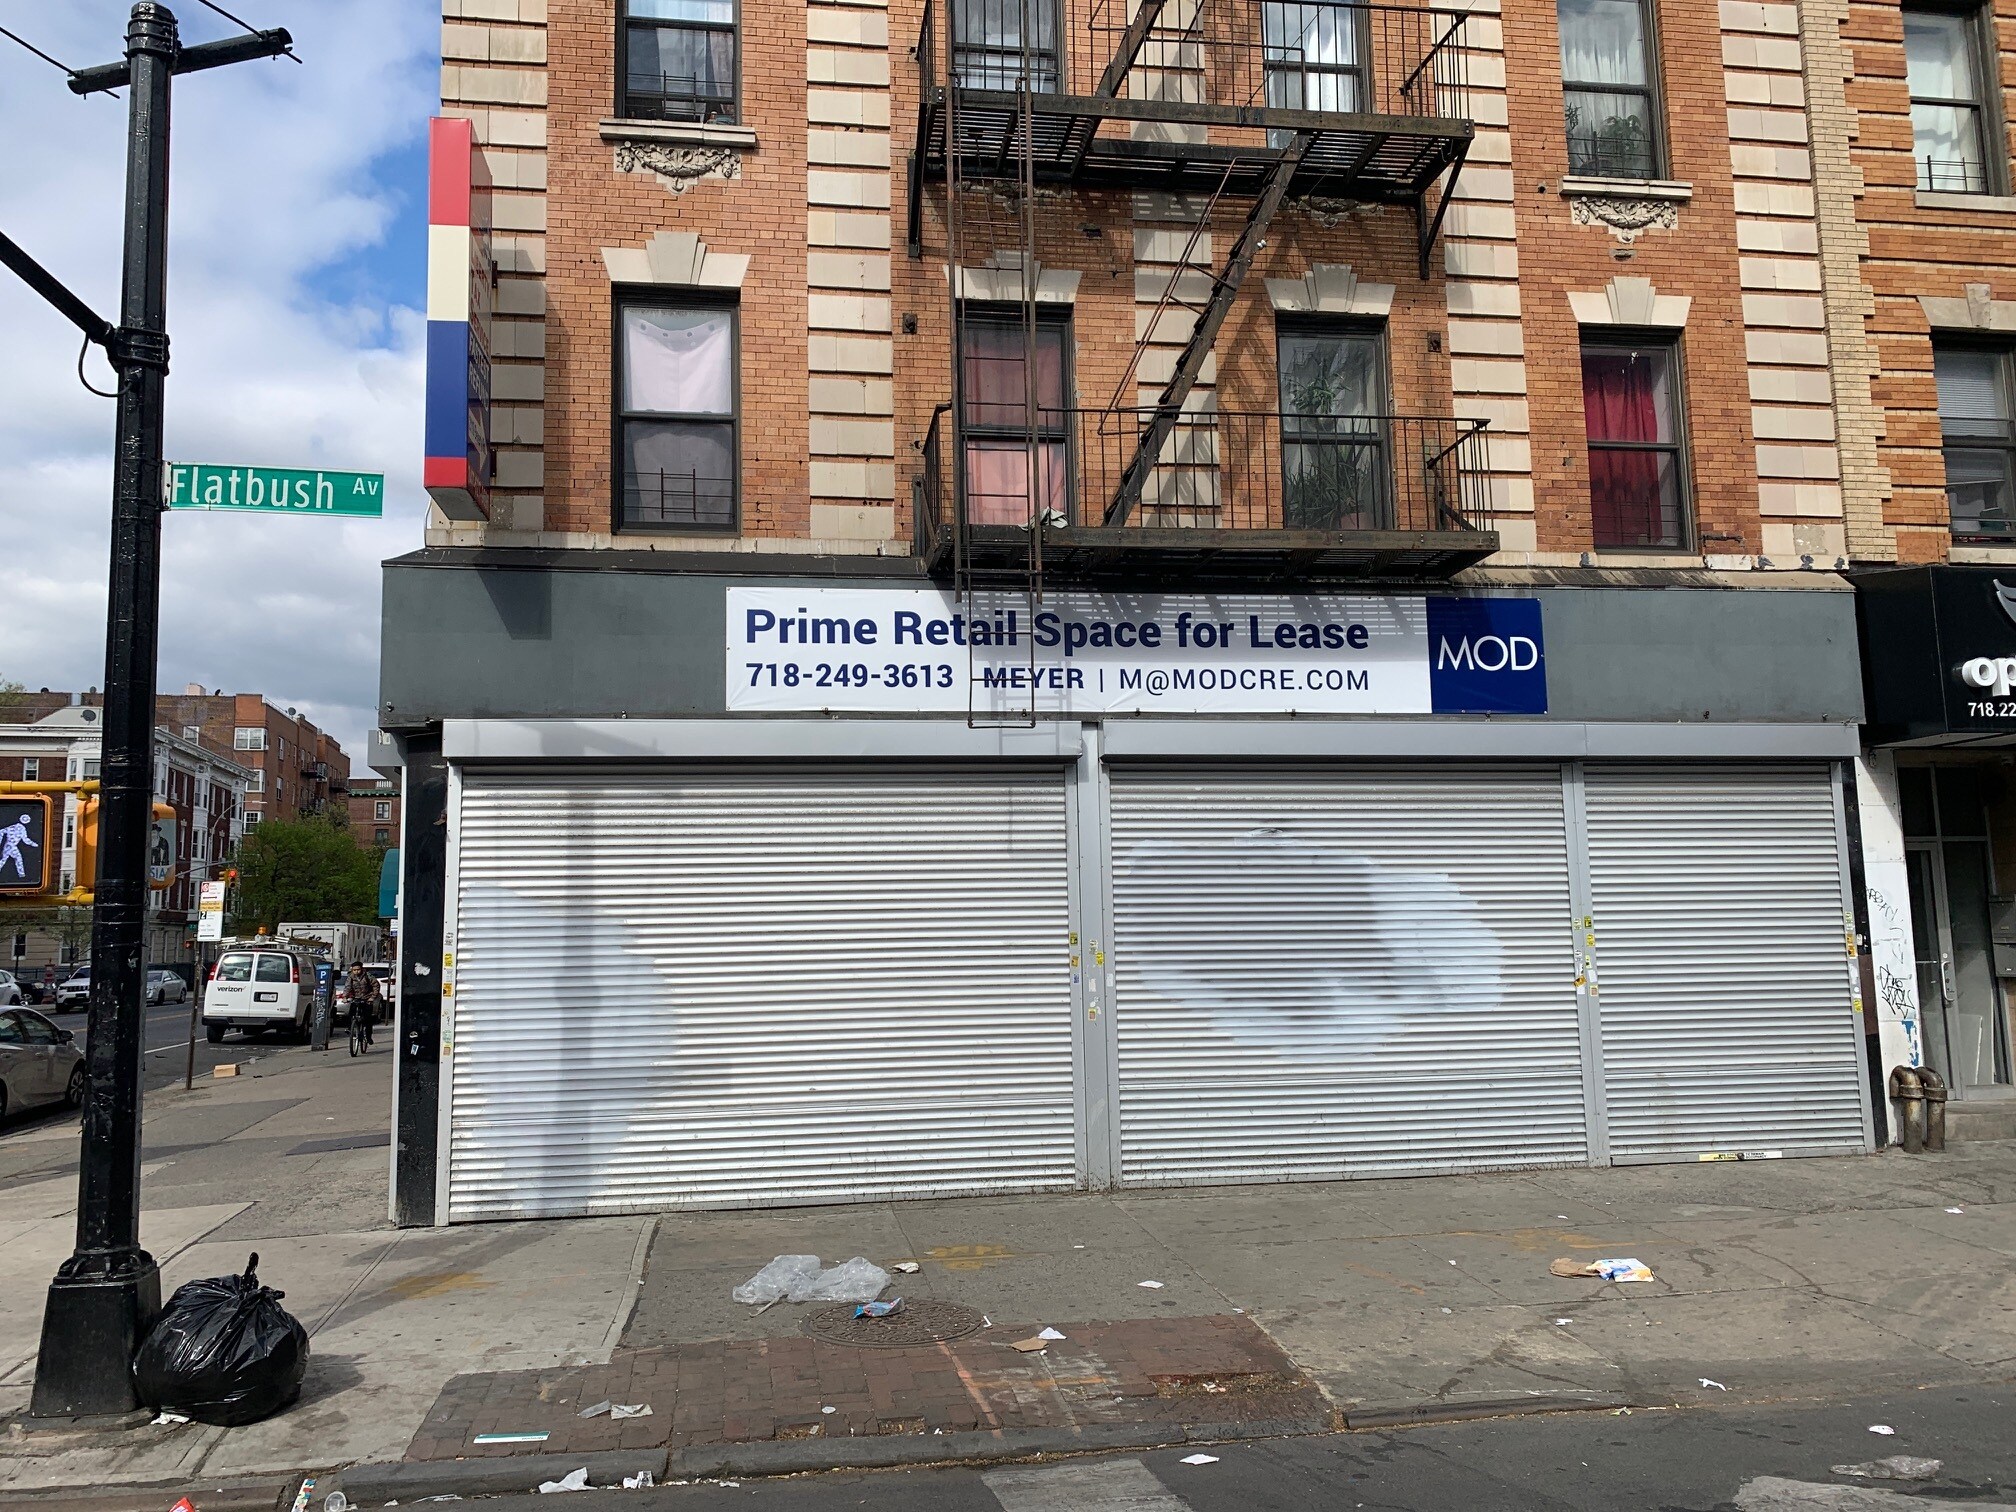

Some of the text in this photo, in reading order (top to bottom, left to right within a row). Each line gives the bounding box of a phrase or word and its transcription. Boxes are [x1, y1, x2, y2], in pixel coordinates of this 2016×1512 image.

[171, 466, 379, 510] Flatbush Av
[746, 607, 1370, 657] Prime Retail Space for Lease
[1437, 635, 1539, 672] MOD
[746, 662, 1370, 696] 718-249-3613 MEYER M@MODCRE.COM
[216, 985, 243, 993] verizon
